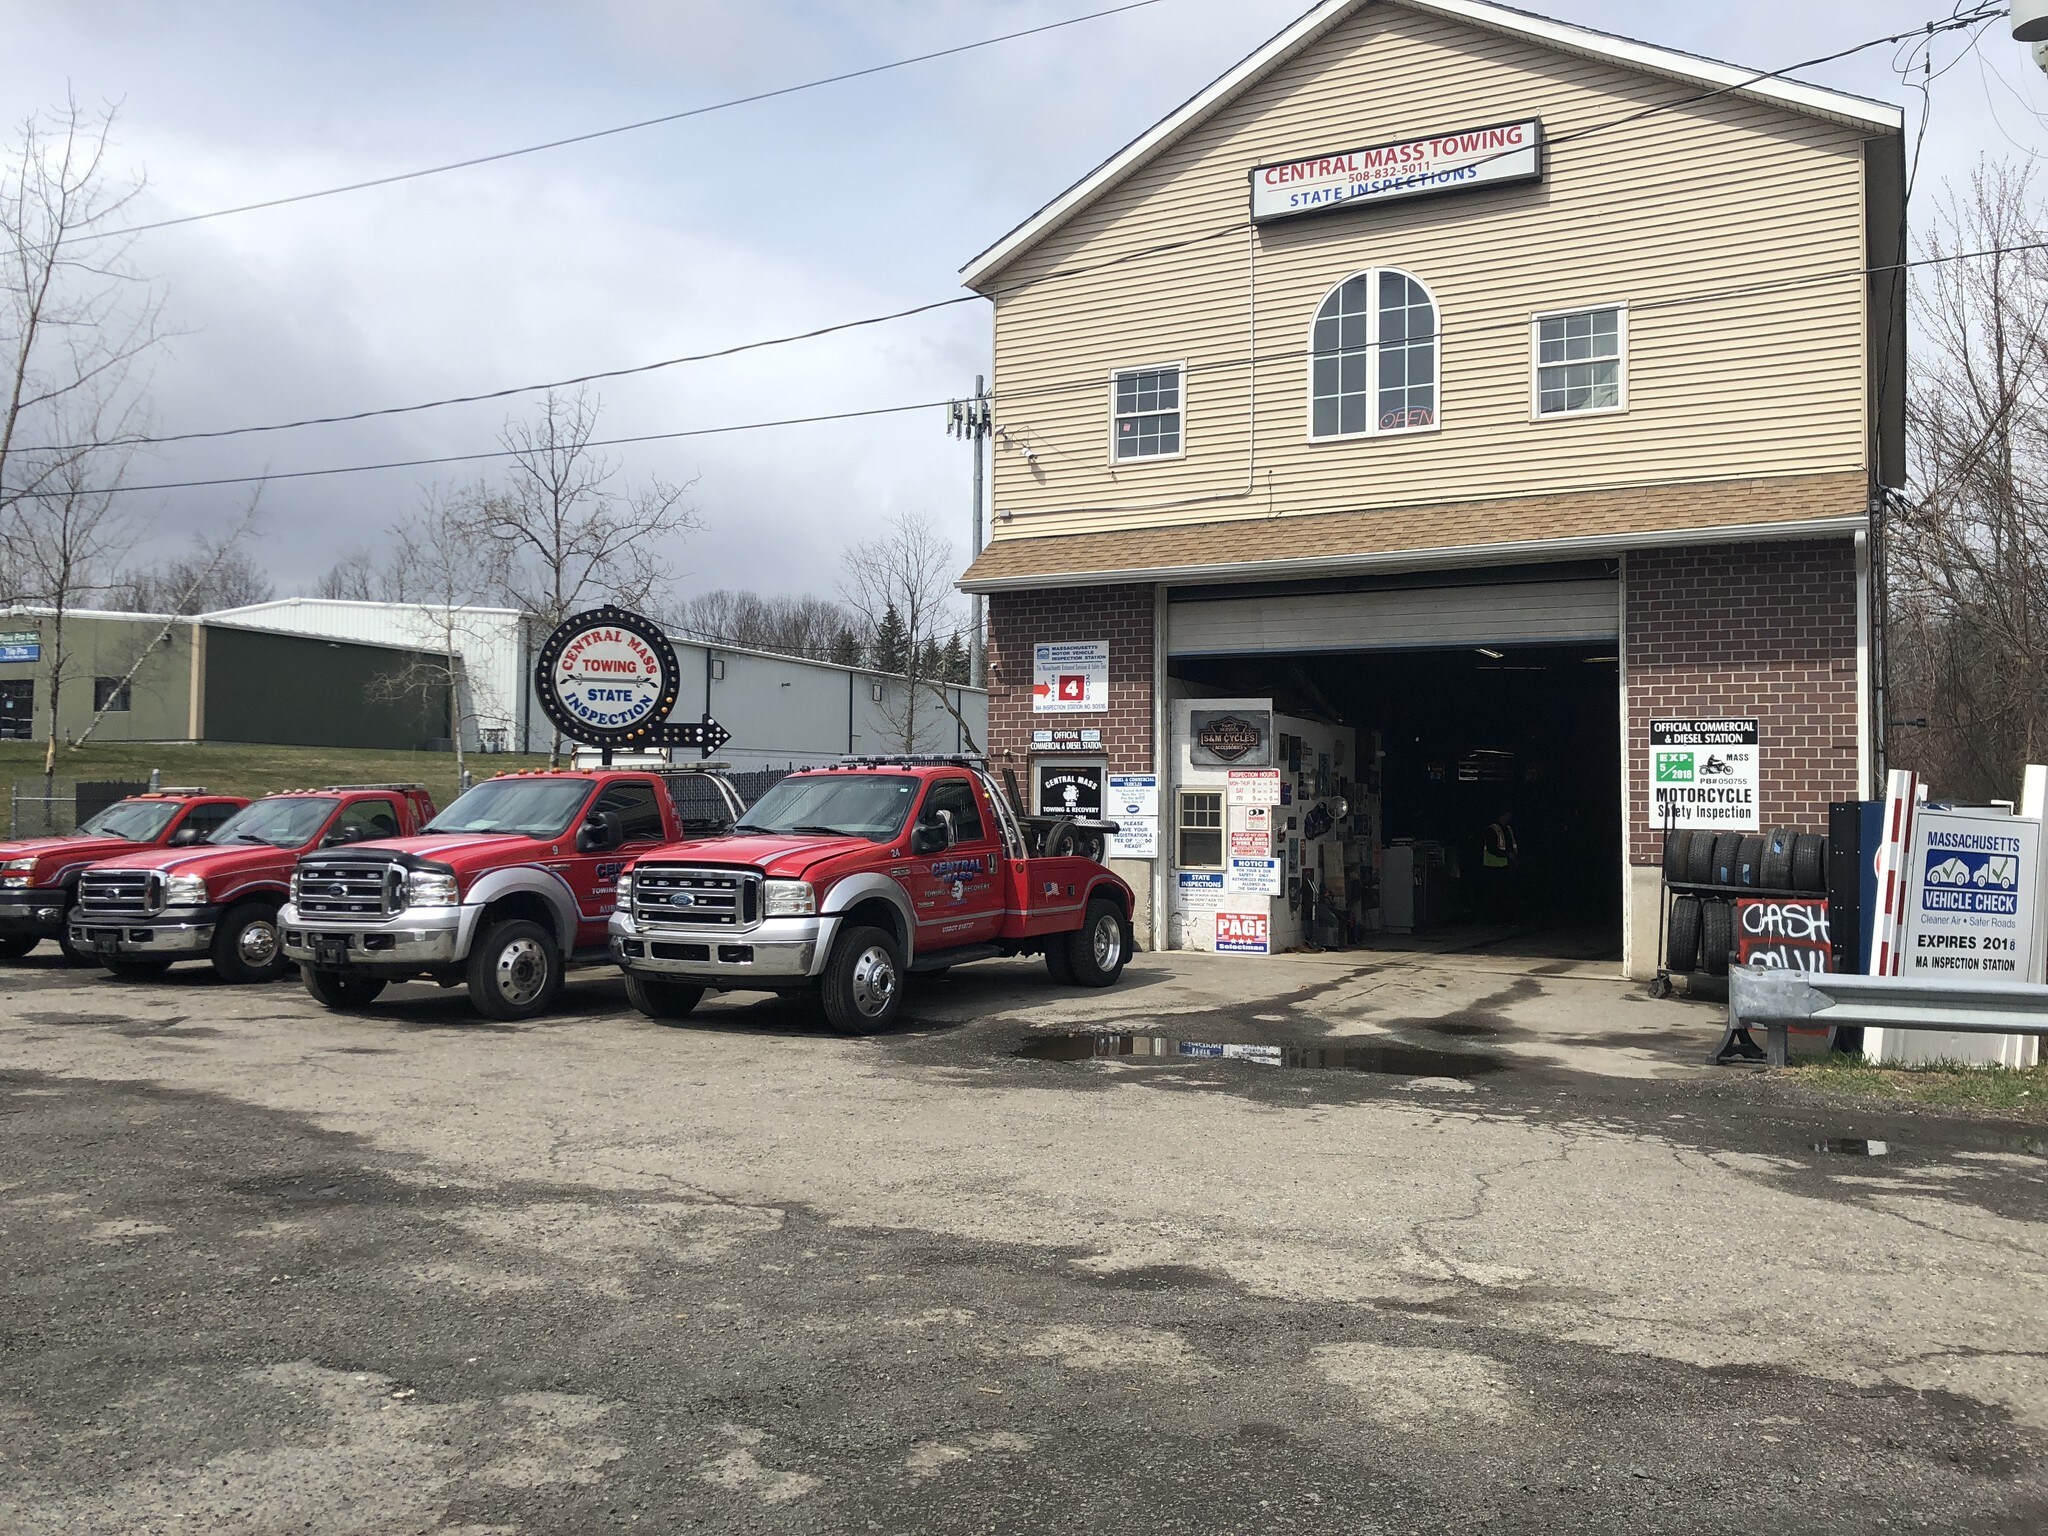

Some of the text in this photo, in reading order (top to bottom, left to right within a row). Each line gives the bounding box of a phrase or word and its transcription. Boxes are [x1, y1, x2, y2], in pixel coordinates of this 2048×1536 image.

[1265, 126, 1522, 185] CENTRAL MASS TOWING
[1348, 160, 1431, 184] 508-832-5011
[1290, 165, 1478, 206] STATE INSPECTIONS
[1380, 410, 1434, 428] OPEN
[562, 630, 658, 674] CENTRAL MASS
[582, 660, 636, 673] TOWING
[588, 688, 632, 702] STATE
[1065, 680, 1078, 696] 4
[565, 692, 653, 725] INSPECTION
[1654, 722, 1754, 732] OFFICIAL COMMERCIAL
[1664, 734, 1743, 743] & DIESEL STATION
[1045, 776, 1098, 790] CENTRAL MASS
[1656, 788, 1752, 803] MOTORCYCLE
[1697, 805, 1751, 820] Inspection
[1927, 831, 2020, 852] MASSACHUSETTS
[552, 845, 559, 855] 9
[891, 849, 900, 857] 2A
[931, 859, 983, 877] CENTRAL
[943, 872, 973, 883] MASS
[964, 884, 990, 892] RECOVERY
[1925, 891, 2014, 912] VEHICLE CHECK
[1218, 919, 1266, 936] PAGE
[1742, 904, 1831, 944] CASH
[1921, 914, 2016, 928] Cleaner Air Safer Roads
[1918, 934, 2016, 951] EXPIRES 2018
[1916, 956, 2015, 971] MA INSPECTION STATION
